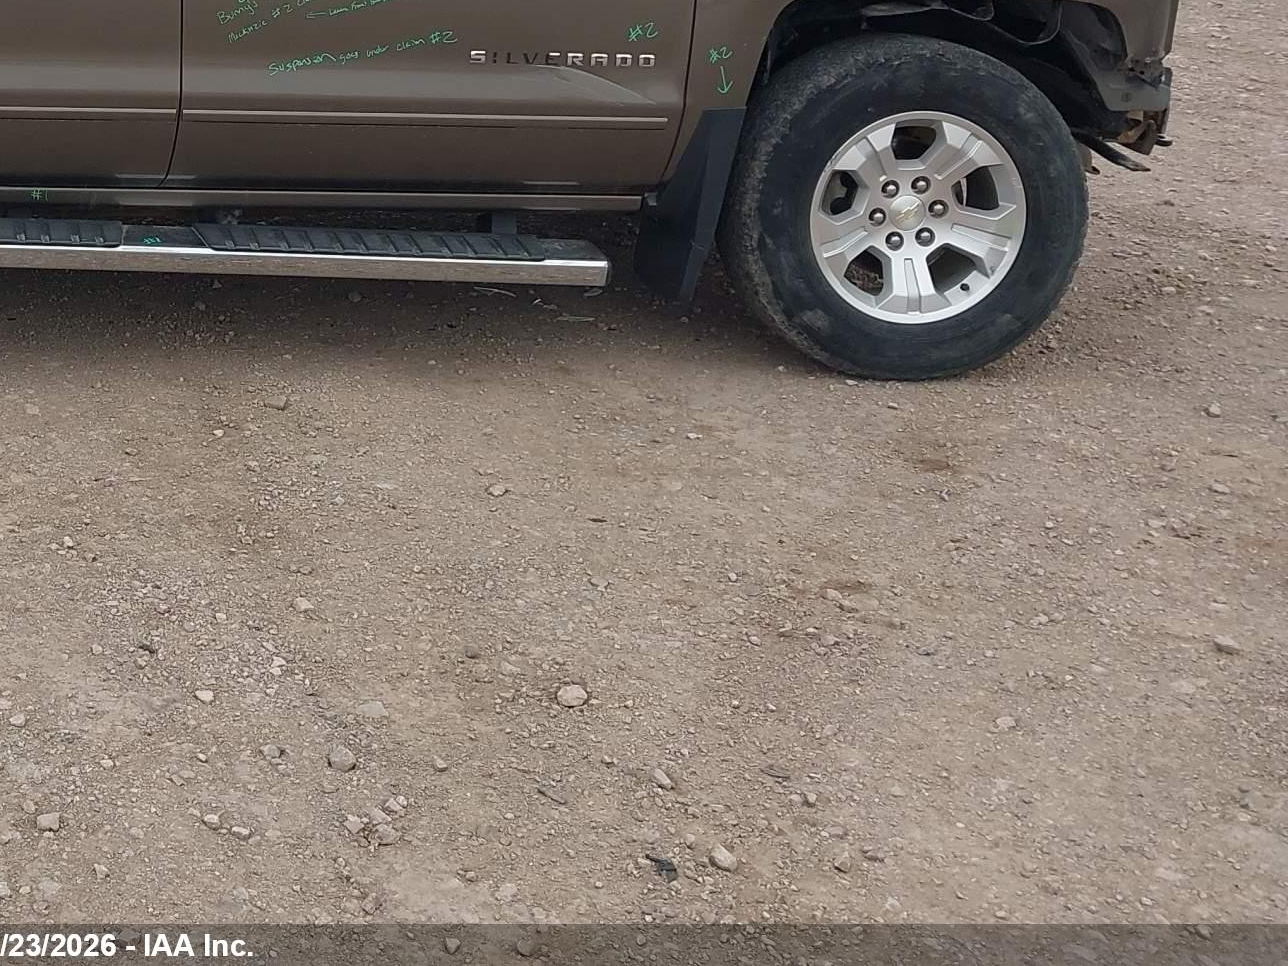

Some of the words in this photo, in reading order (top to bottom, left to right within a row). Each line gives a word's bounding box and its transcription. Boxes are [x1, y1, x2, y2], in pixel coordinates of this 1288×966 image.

[272, 4, 293, 18] #2
[429, 30, 458, 44] #2
[628, 22, 659, 42] #2
[469, 50, 656, 67] SILVERADO
[708, 46, 734, 63] #2
